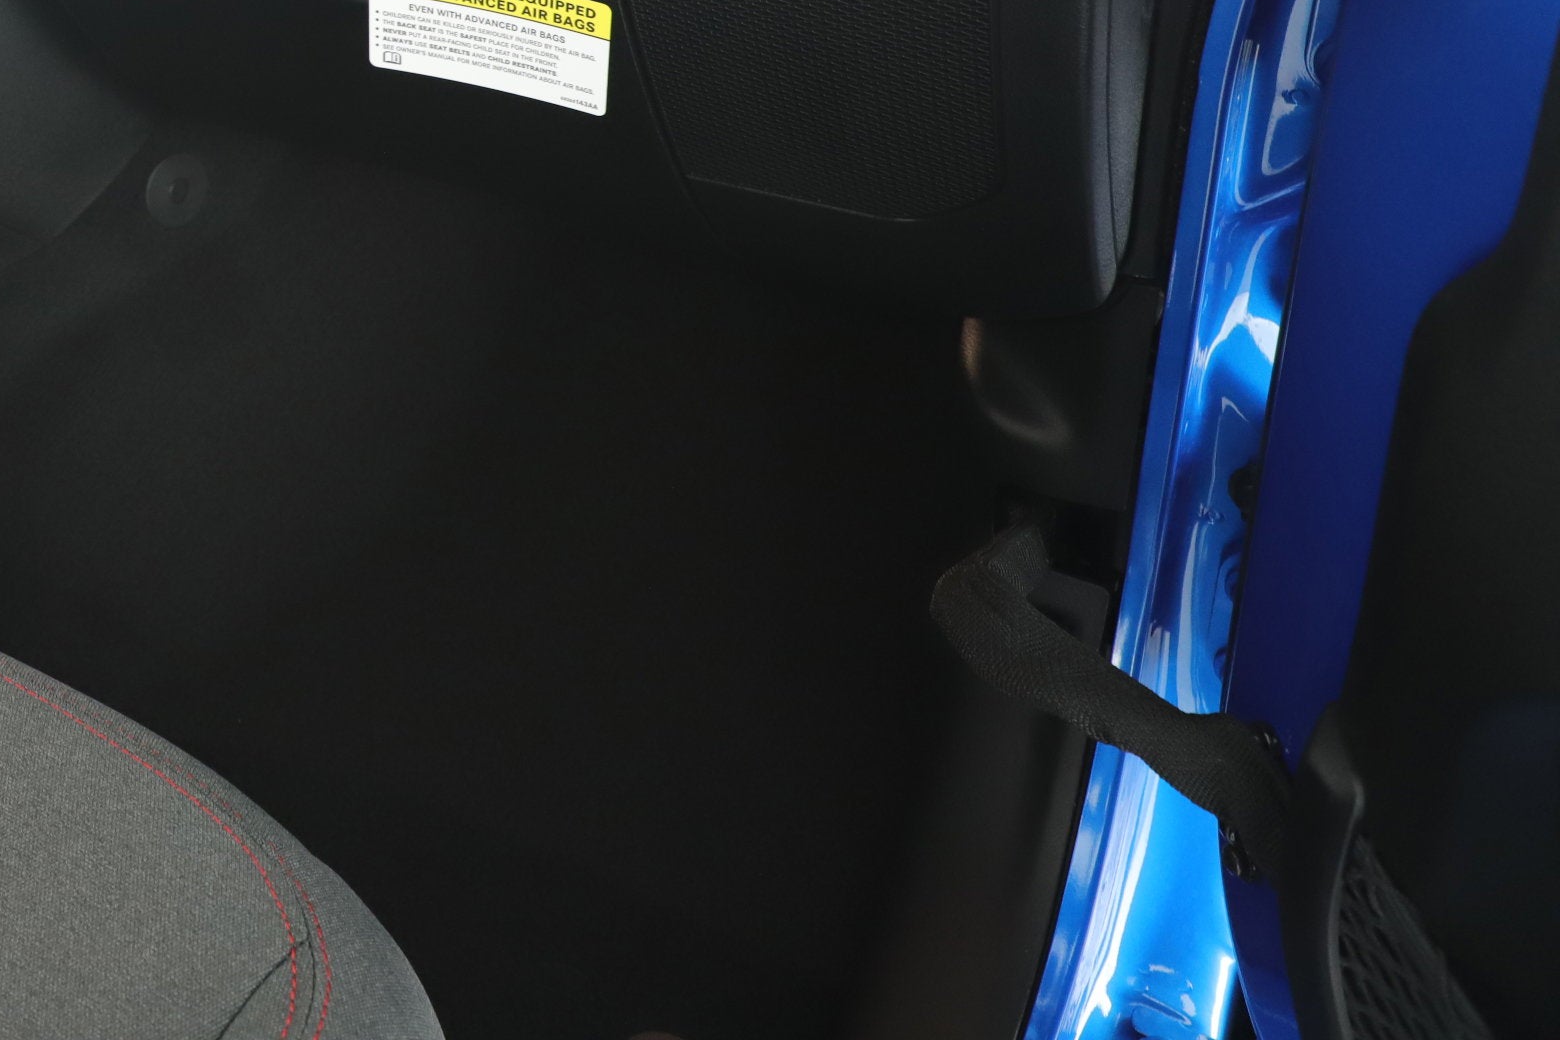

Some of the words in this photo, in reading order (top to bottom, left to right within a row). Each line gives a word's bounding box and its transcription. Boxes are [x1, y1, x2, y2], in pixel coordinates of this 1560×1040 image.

[383, 11, 415, 21] CHILDREN
[443, 21, 465, 30] KILLED
[478, 28, 513, 40] SERIOUSLY
[515, 37, 542, 48] INJURED
[409, 4, 433, 14] EVEN
[437, 9, 461, 20] WITH
[465, 15, 517, 31] ADVANCED
[521, 27, 536, 36] AIR
[540, 31, 565, 43] BAGS
[522, 6, 547, 20] AIR
[553, 13, 595, 32] BAGS
[383, 28, 406, 36] NEVER
[429, 36, 471, 48] REAR-FACING
[473, 44, 492, 52] CHILD
[495, 49, 510, 57] SEAT
[521, 54, 533, 62] THE
[383, 36, 412, 45] ALWAYS
[449, 48, 470, 56] BELTS
[488, 55, 510, 64] CHILD
[489, 39, 509, 48] PLACE
[511, 41, 523, 51] FOR
[525, 47, 559, 60] CHILDREN.
[428, 51, 454, 61] MANUAL
[472, 60, 490, 69] MORE
[492, 64, 537, 80] INFORMATION
[539, 76, 561, 85] ABOUT
[576, 85, 594, 95] BAGS.
